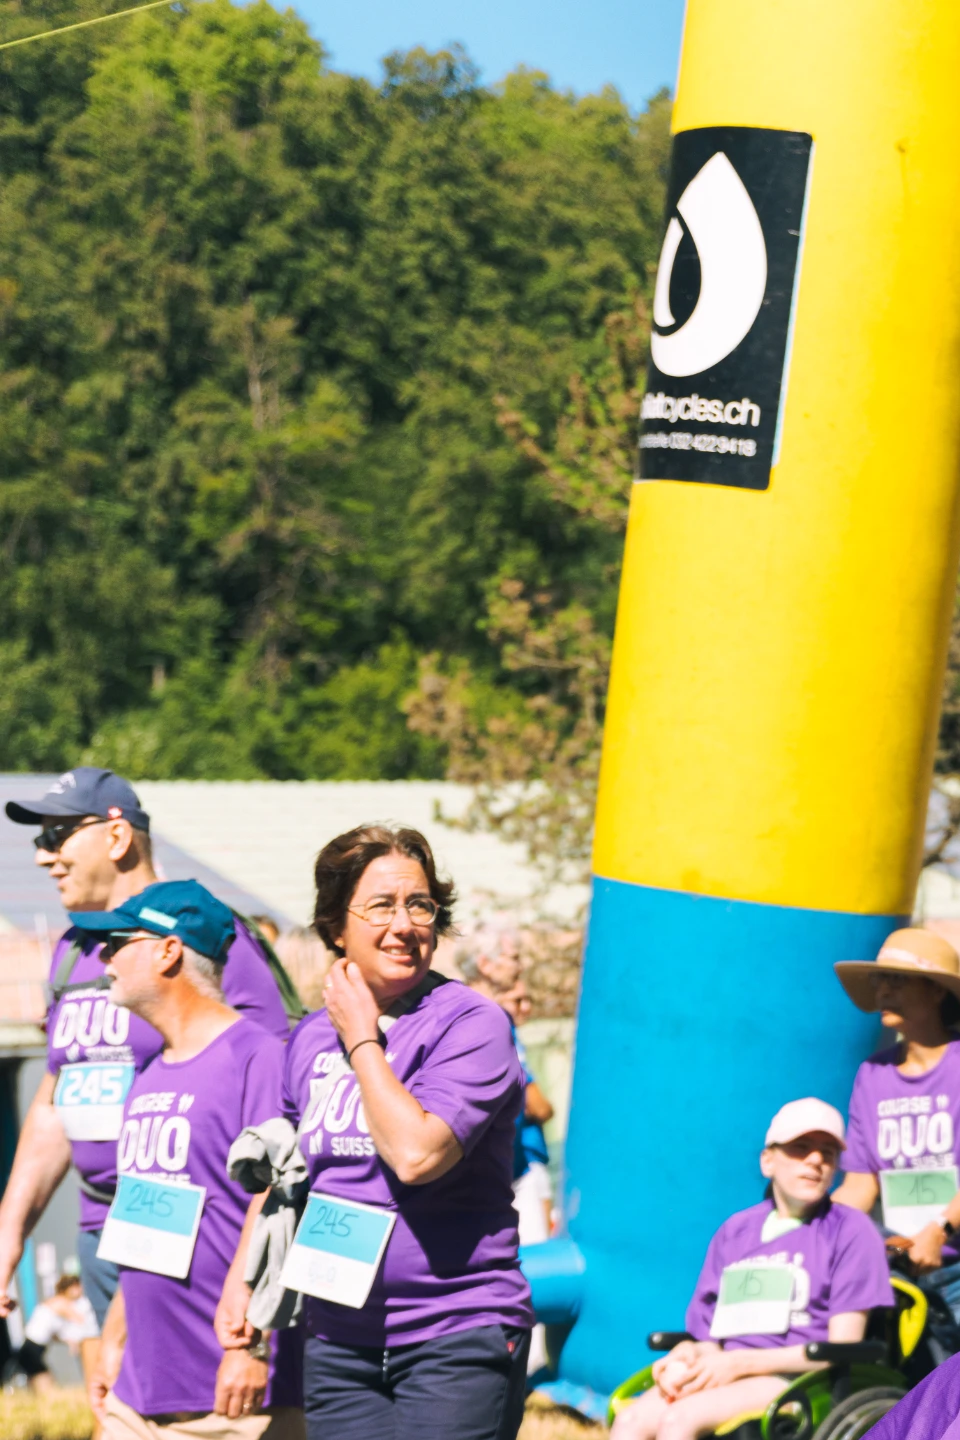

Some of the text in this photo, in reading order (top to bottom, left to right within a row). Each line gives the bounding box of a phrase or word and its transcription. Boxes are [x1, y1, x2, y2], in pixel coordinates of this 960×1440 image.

[52, 1000, 131, 1049] DUO
[62, 1068, 124, 1106] 245
[877, 1095, 931, 1117] COURSE
[117, 1115, 191, 1172] DUO
[330, 1136, 376, 1157] SUISS
[877, 1111, 954, 1160] DUO
[126, 1183, 180, 1218] 245
[908, 1175, 937, 1204] 15
[309, 1205, 359, 1238] 245
